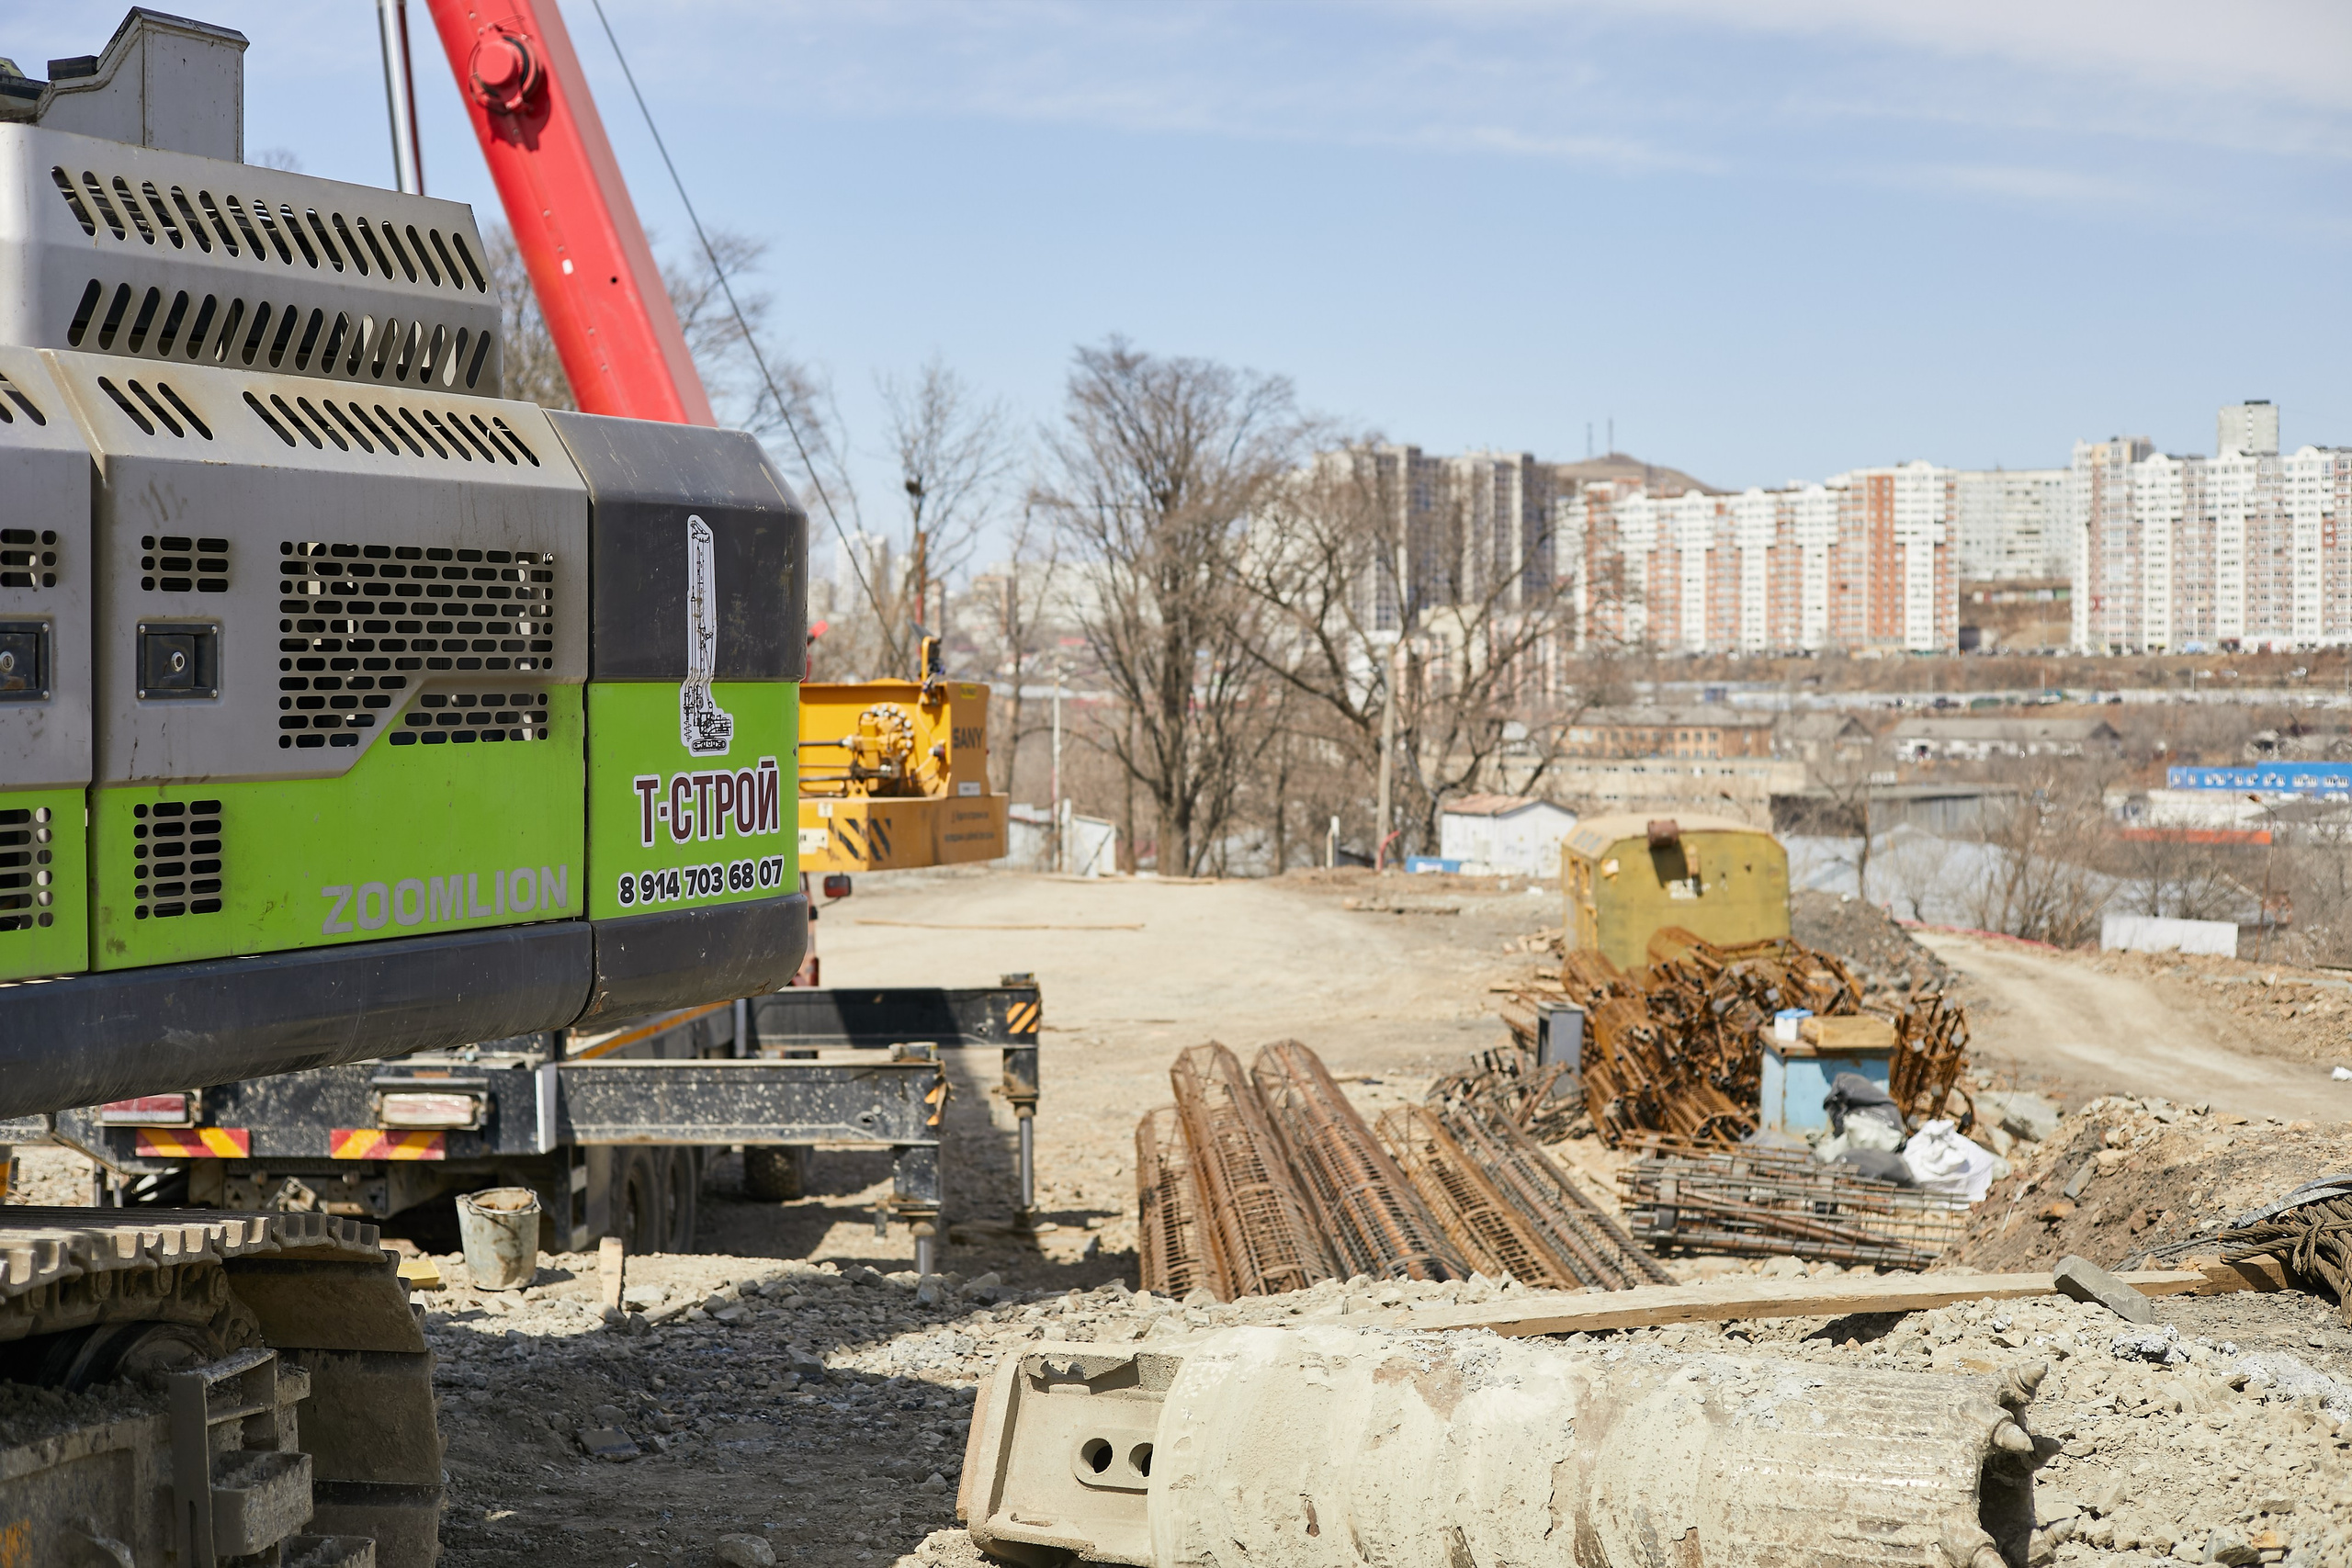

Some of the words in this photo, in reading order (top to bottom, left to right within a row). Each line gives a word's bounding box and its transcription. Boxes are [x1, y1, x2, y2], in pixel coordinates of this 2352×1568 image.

[953, 727, 983, 749] SANY
[636, 761, 778, 842] Т-СТРОЙ
[322, 864, 568, 935] ZOOMLION
[620, 876, 634, 904] 8
[642, 871, 679, 901] 914
[684, 866, 723, 897] 703
[729, 863, 753, 890] 68
[759, 858, 783, 886] 07
